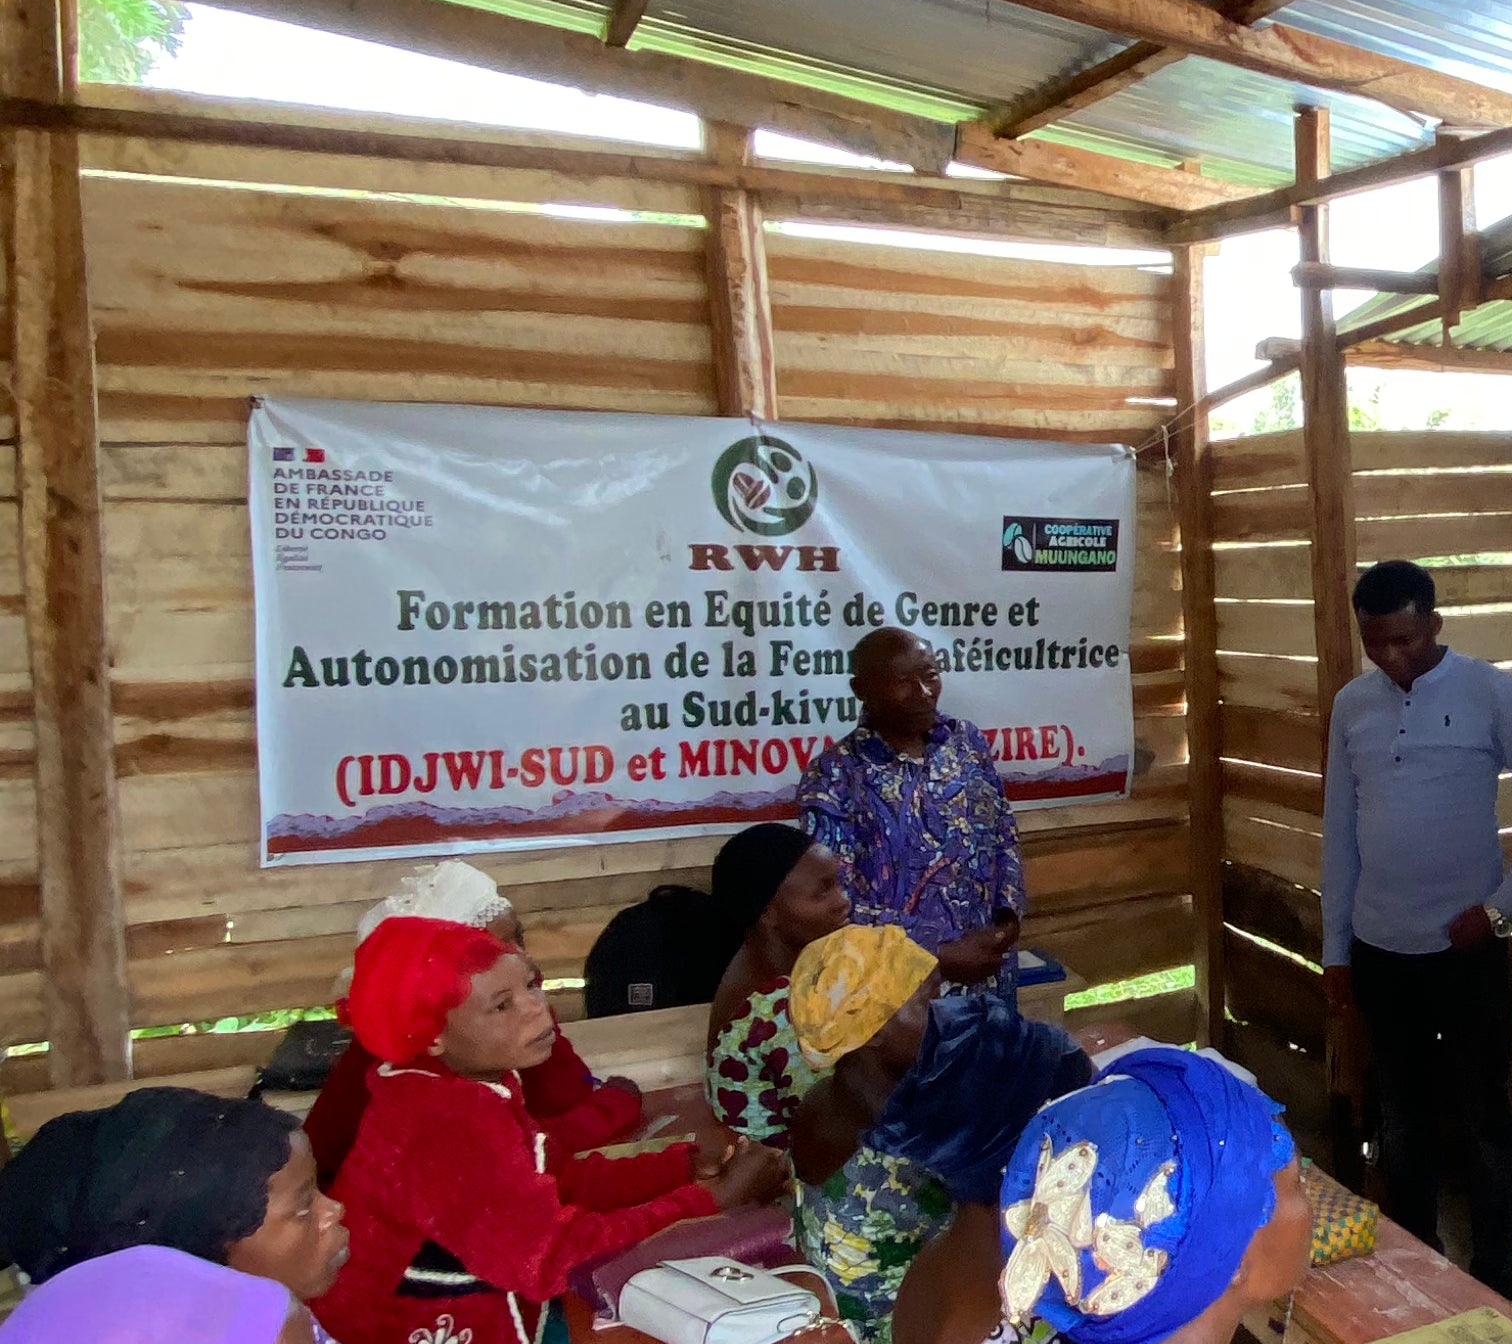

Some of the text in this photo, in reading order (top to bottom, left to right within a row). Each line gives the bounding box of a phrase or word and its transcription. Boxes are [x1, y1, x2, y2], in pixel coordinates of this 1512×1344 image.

[273, 468, 393, 482] AMBASSADE
[274, 483, 385, 496] DE FRANCE
[274, 497, 425, 513] EN RÉPUBLIQUE
[275, 511, 433, 528] DÉMOCRATIQUE
[276, 528, 387, 540] DU CONGO
[1049, 536, 1107, 547] AGRICOLE
[688, 544, 840, 572] RWH
[1035, 550, 1116, 565] MUUNGANO
[397, 590, 1040, 637] Formation en Equité de Genre et
[282, 637, 1119, 687] Autonomisation de la Fem aféicultrice
[621, 689, 857, 731] au Sud-kivu
[336, 745, 614, 807] (IDJWI-SUD
[627, 747, 666, 781] et
